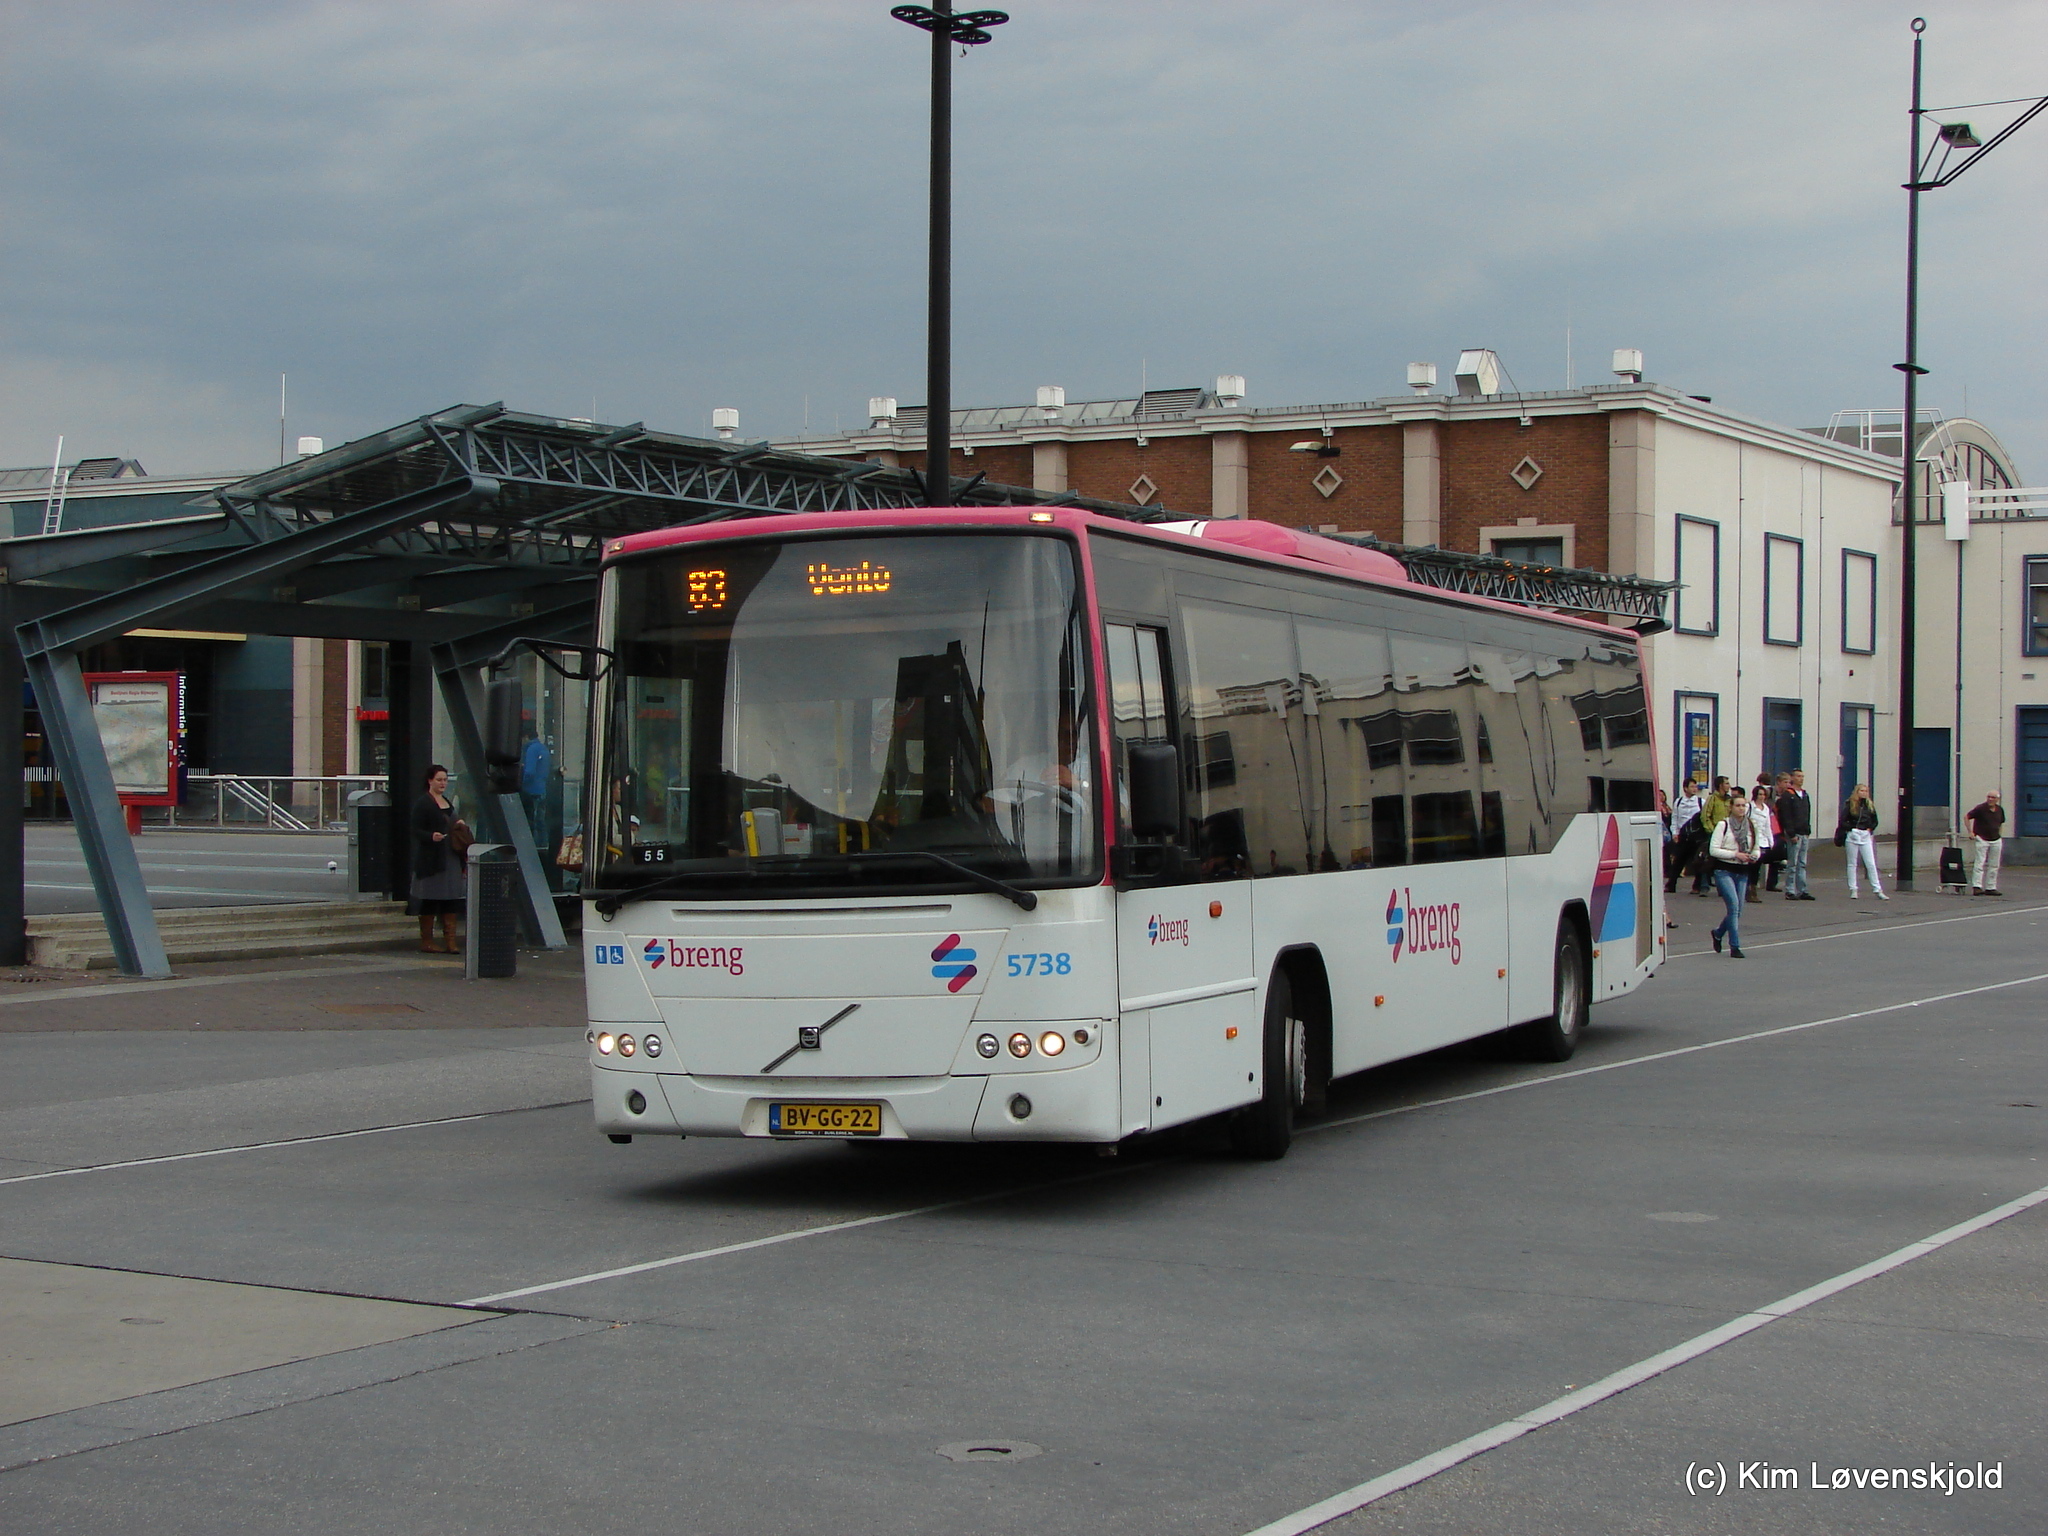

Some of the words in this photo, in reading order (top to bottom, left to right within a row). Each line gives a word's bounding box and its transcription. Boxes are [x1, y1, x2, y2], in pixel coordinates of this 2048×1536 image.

[807, 561, 891, 595] Venlo
[179, 675, 187, 729] Informatie
[1158, 914, 1189, 947] breng
[1404, 887, 1462, 966] breng
[668, 938, 744, 976] breng
[1007, 952, 1072, 977] 5738
[787, 1108, 873, 1128] BV-GG-22
